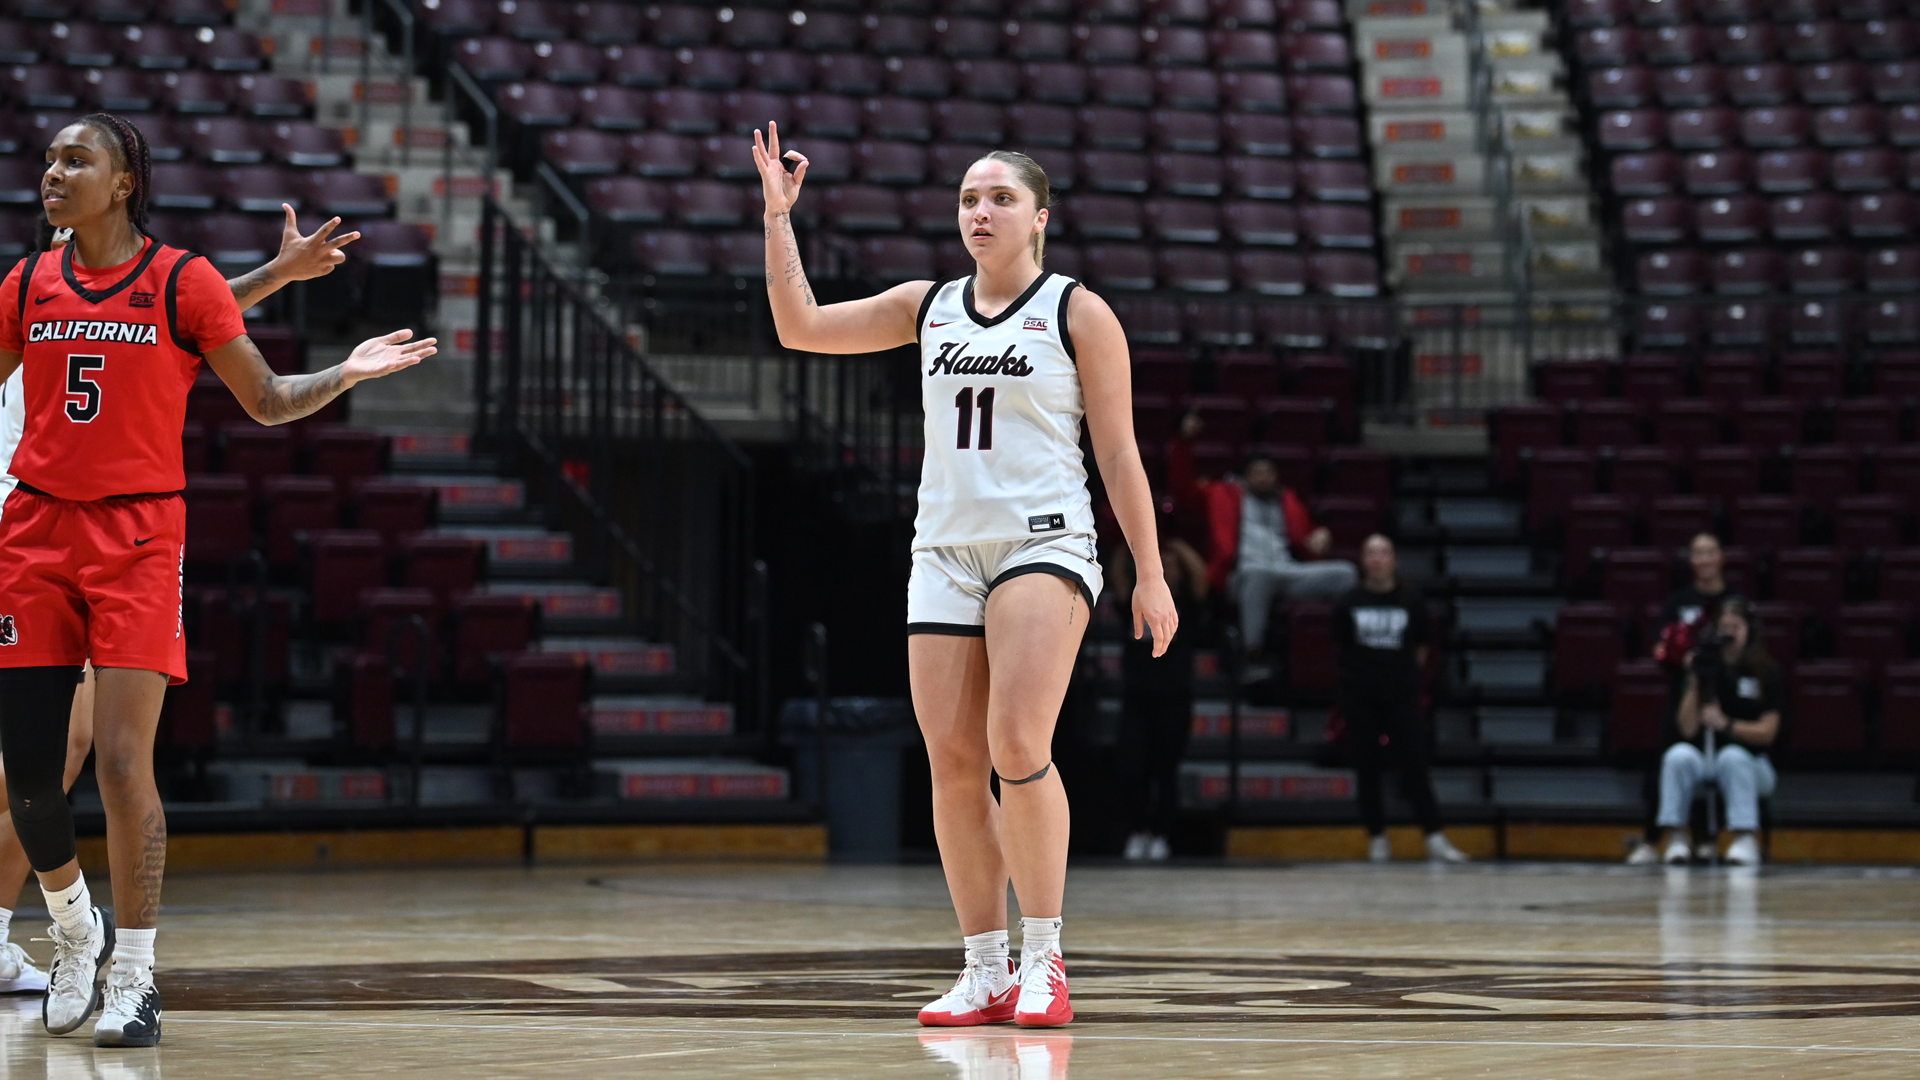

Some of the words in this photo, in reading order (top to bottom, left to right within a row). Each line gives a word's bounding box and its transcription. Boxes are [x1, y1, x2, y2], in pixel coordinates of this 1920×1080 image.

[129, 295, 155, 304] PSAC
[28, 320, 158, 346] CALIFORNIA
[1023, 320, 1048, 328] PSAC
[928, 341, 1034, 377] Hawks
[64, 353, 105, 424] 5
[955, 386, 995, 451] 11
